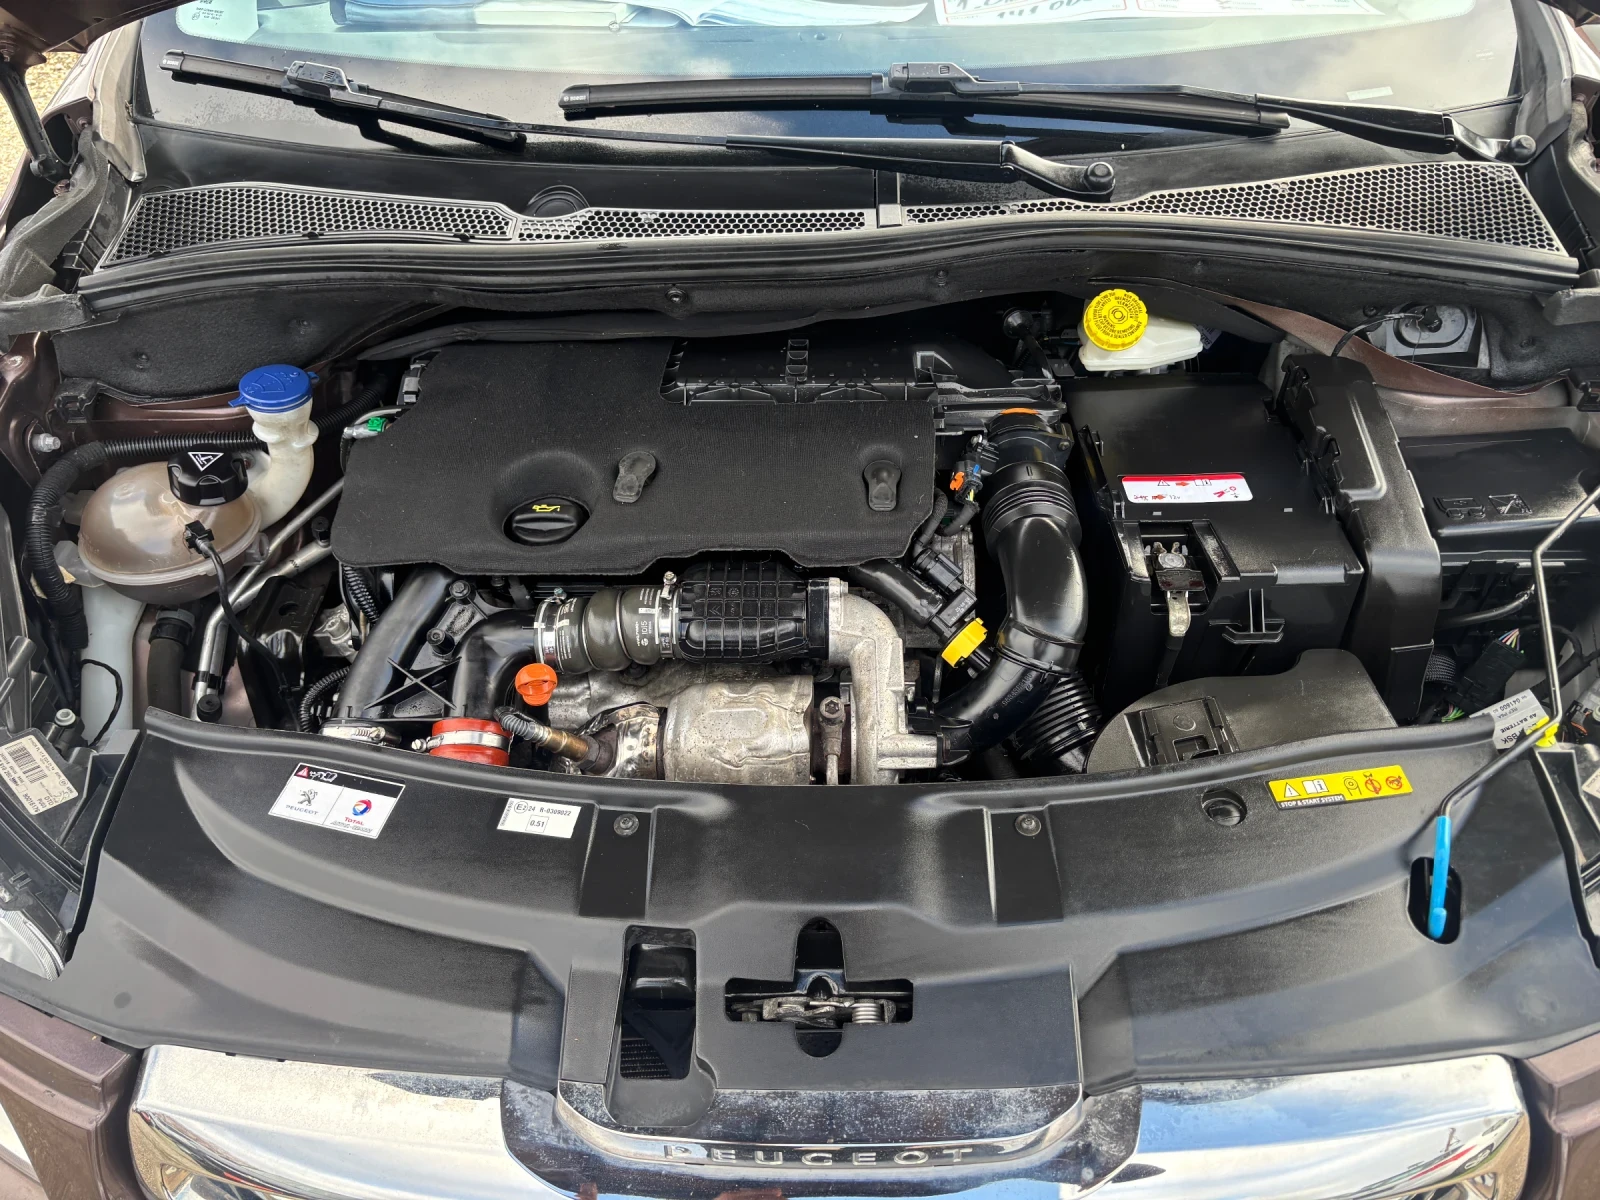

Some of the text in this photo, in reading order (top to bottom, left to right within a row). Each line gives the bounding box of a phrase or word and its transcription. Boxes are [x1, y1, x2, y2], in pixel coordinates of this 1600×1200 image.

[1322, 795, 1344, 804] SYSTEM
[286, 804, 318, 815] PEUGEOT
[344, 817, 364, 826] TOTAL
[664, 1144, 973, 1166] PEUGEOT
